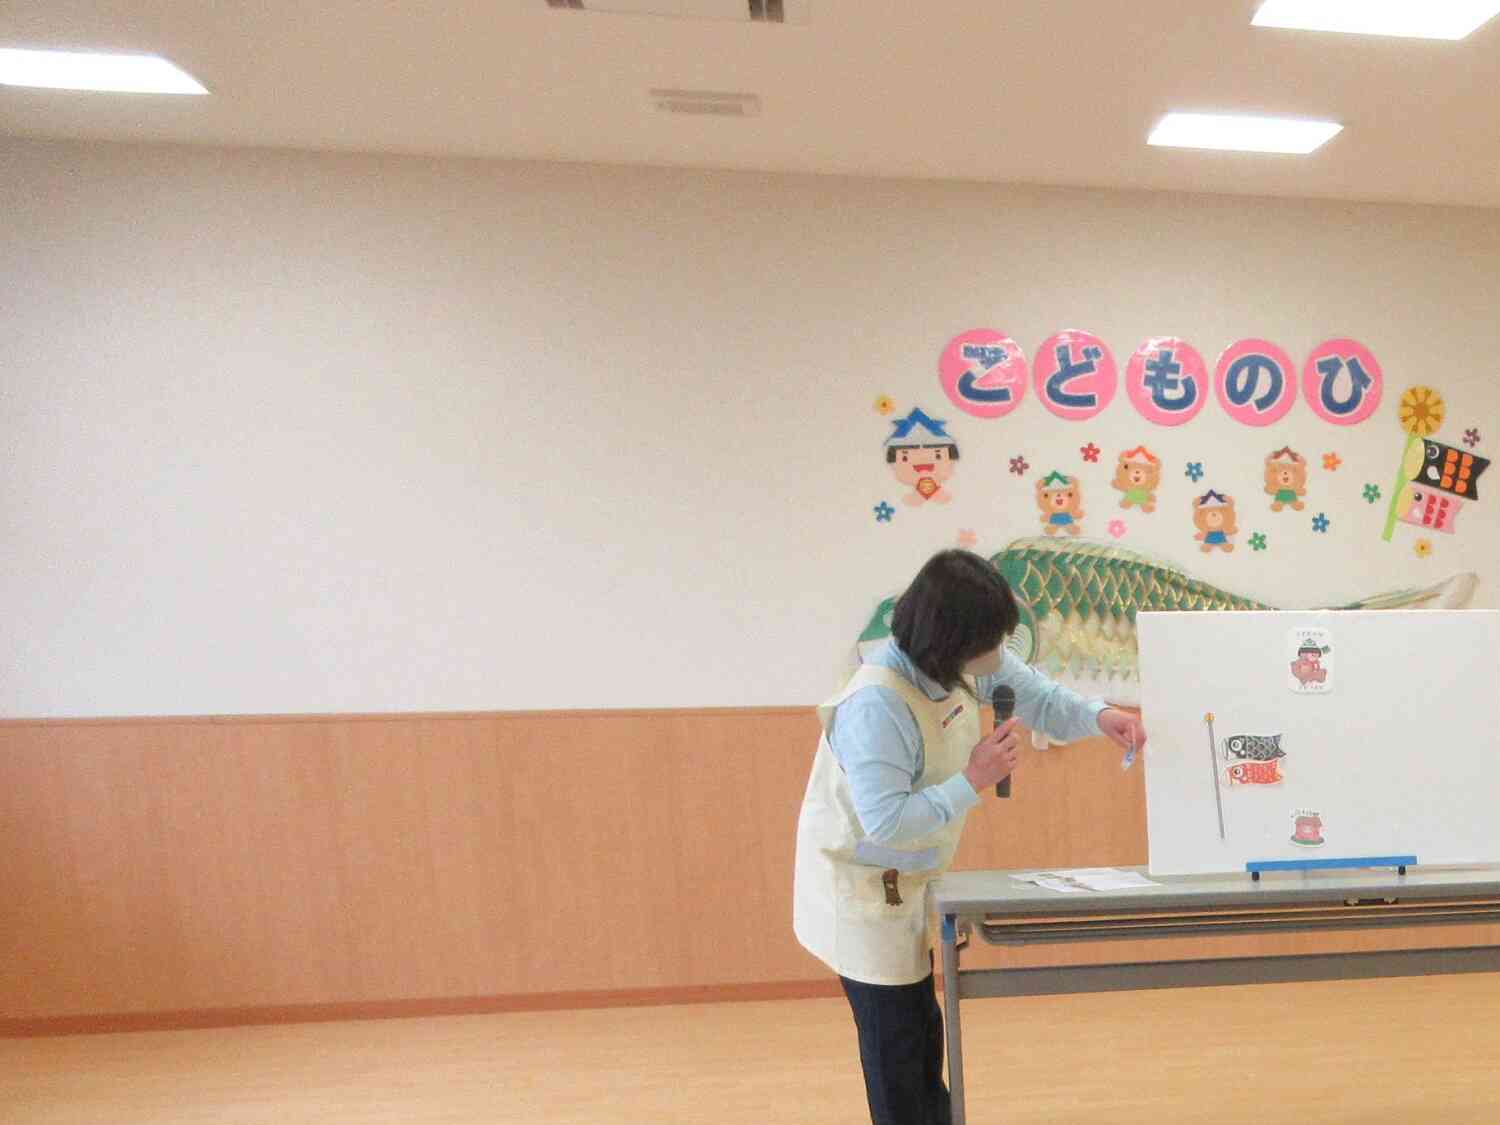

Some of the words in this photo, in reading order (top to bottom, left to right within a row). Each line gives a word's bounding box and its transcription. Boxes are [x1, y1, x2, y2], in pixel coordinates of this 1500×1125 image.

[957, 343, 1372, 415] こどものひ
